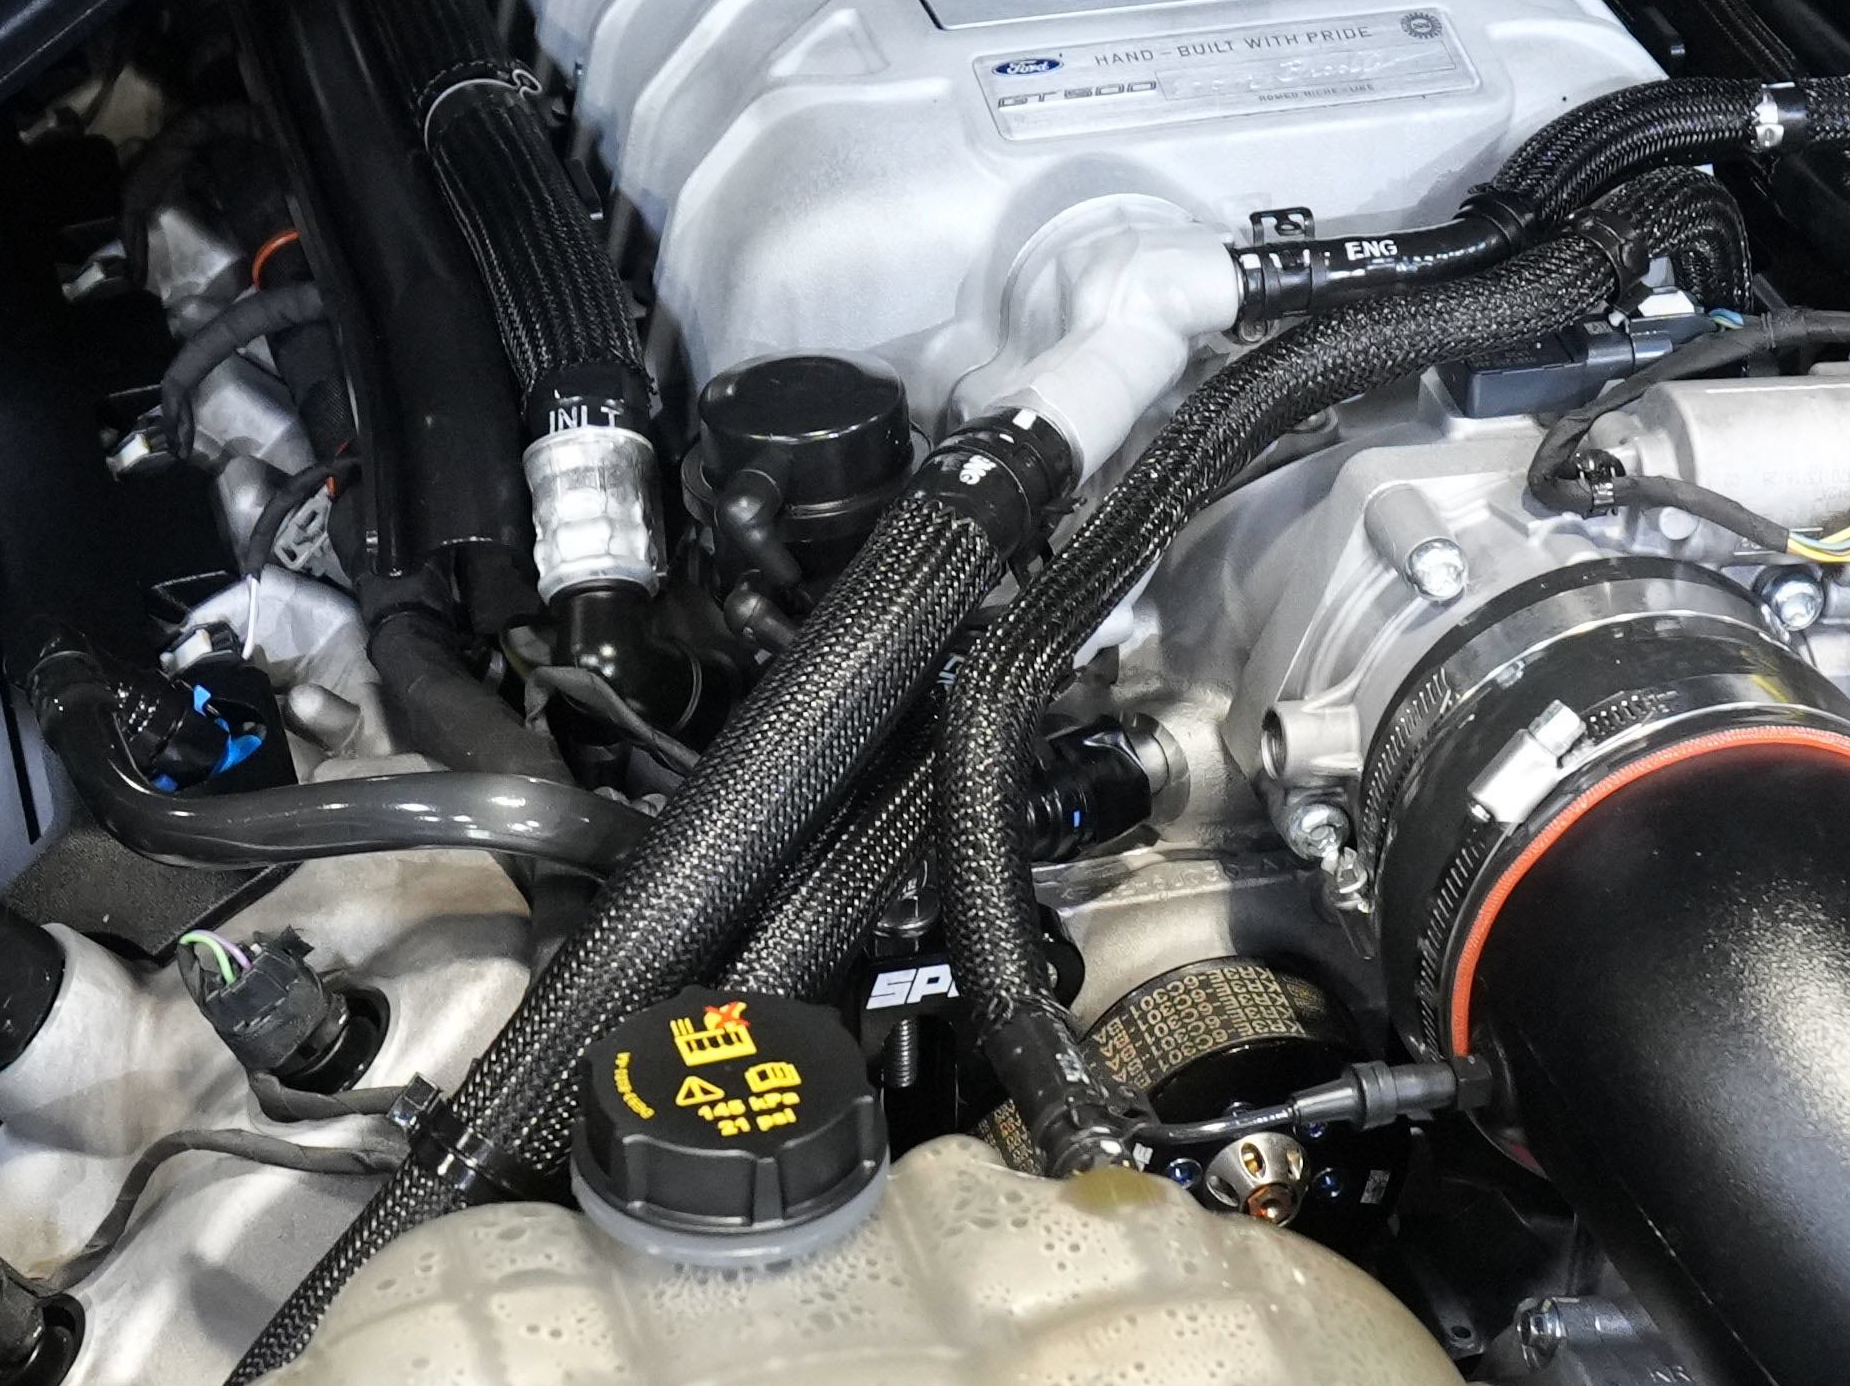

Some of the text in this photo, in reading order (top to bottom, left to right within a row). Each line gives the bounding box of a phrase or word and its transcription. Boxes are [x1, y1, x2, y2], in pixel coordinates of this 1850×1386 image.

[1095, 48, 1155, 66] HAND
[1177, 39, 1235, 58] BUILT
[1244, 33, 1300, 50] WITH
[1306, 25, 1374, 44] PRIDE
[1003, 58, 1053, 76] Ford
[1344, 239, 1398, 261] ENG
[866, 963, 960, 1010] SP
[698, 1091, 800, 1121] 145 kPa
[717, 1107, 797, 1137] 21 psi
